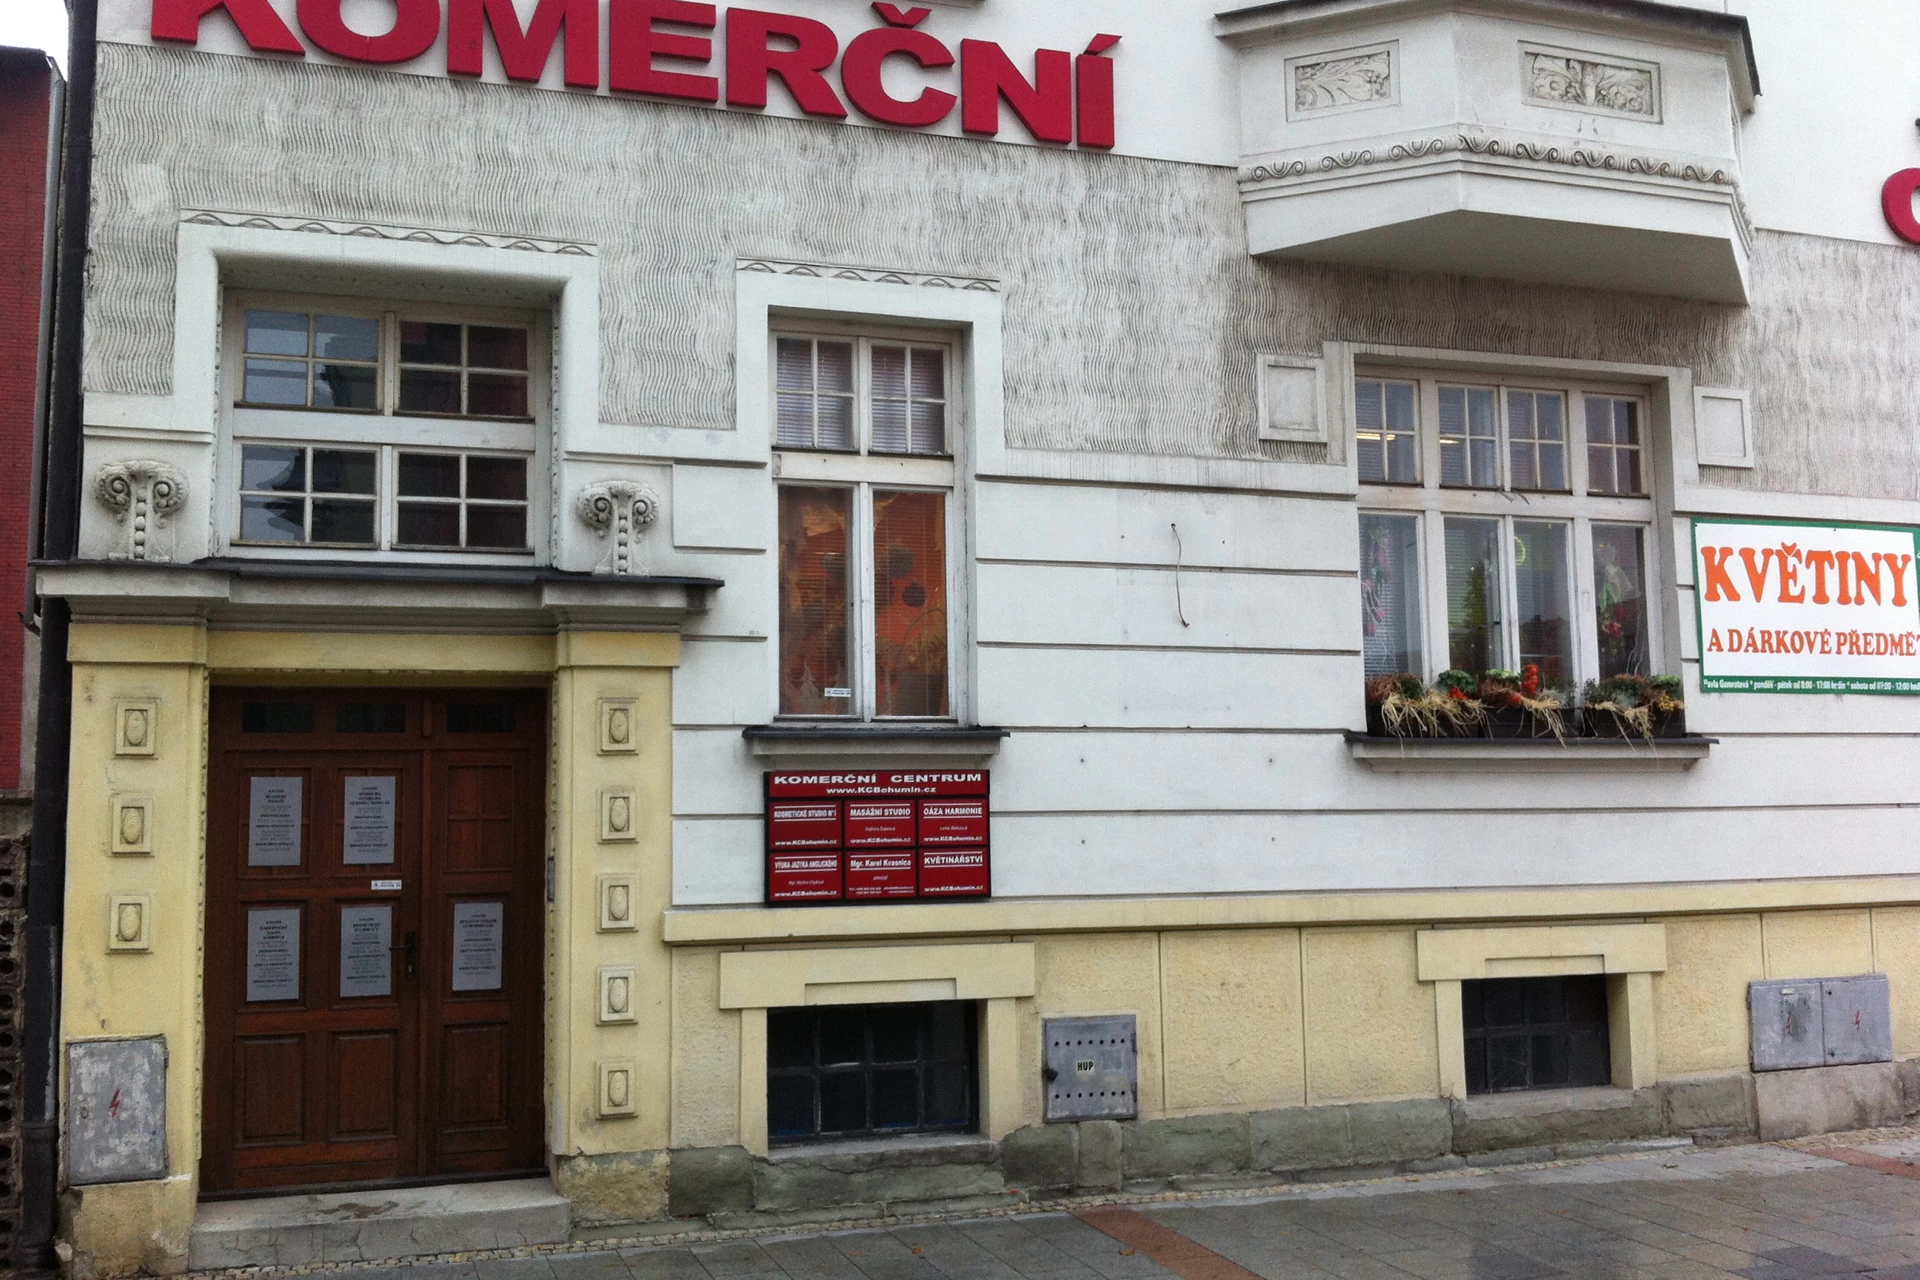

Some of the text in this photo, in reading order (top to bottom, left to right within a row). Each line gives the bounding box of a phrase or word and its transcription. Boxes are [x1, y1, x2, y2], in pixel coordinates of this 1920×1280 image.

[1701, 542, 1912, 607] KVĚTINY
[1707, 626, 1920, 656] A DÁRKOVÉ PŘEDMĚ
[1816, 681, 1831, 689] 17:00
[774, 773, 982, 784] KOMERČNÍ CENTRUM
[826, 786, 937, 794] www.KCBohumin.cz
[808, 809, 827, 817] STUDIO
[850, 807, 911, 816] MASÁŽNÍ STUDIO
[923, 806, 982, 815] OÁZA HARMONIE
[850, 858, 911, 869] Mgr. Karel Kvasnica
[924, 854, 983, 864] KVĚTINÁŘSTVÍ
[1077, 1061, 1094, 1071] HUP
